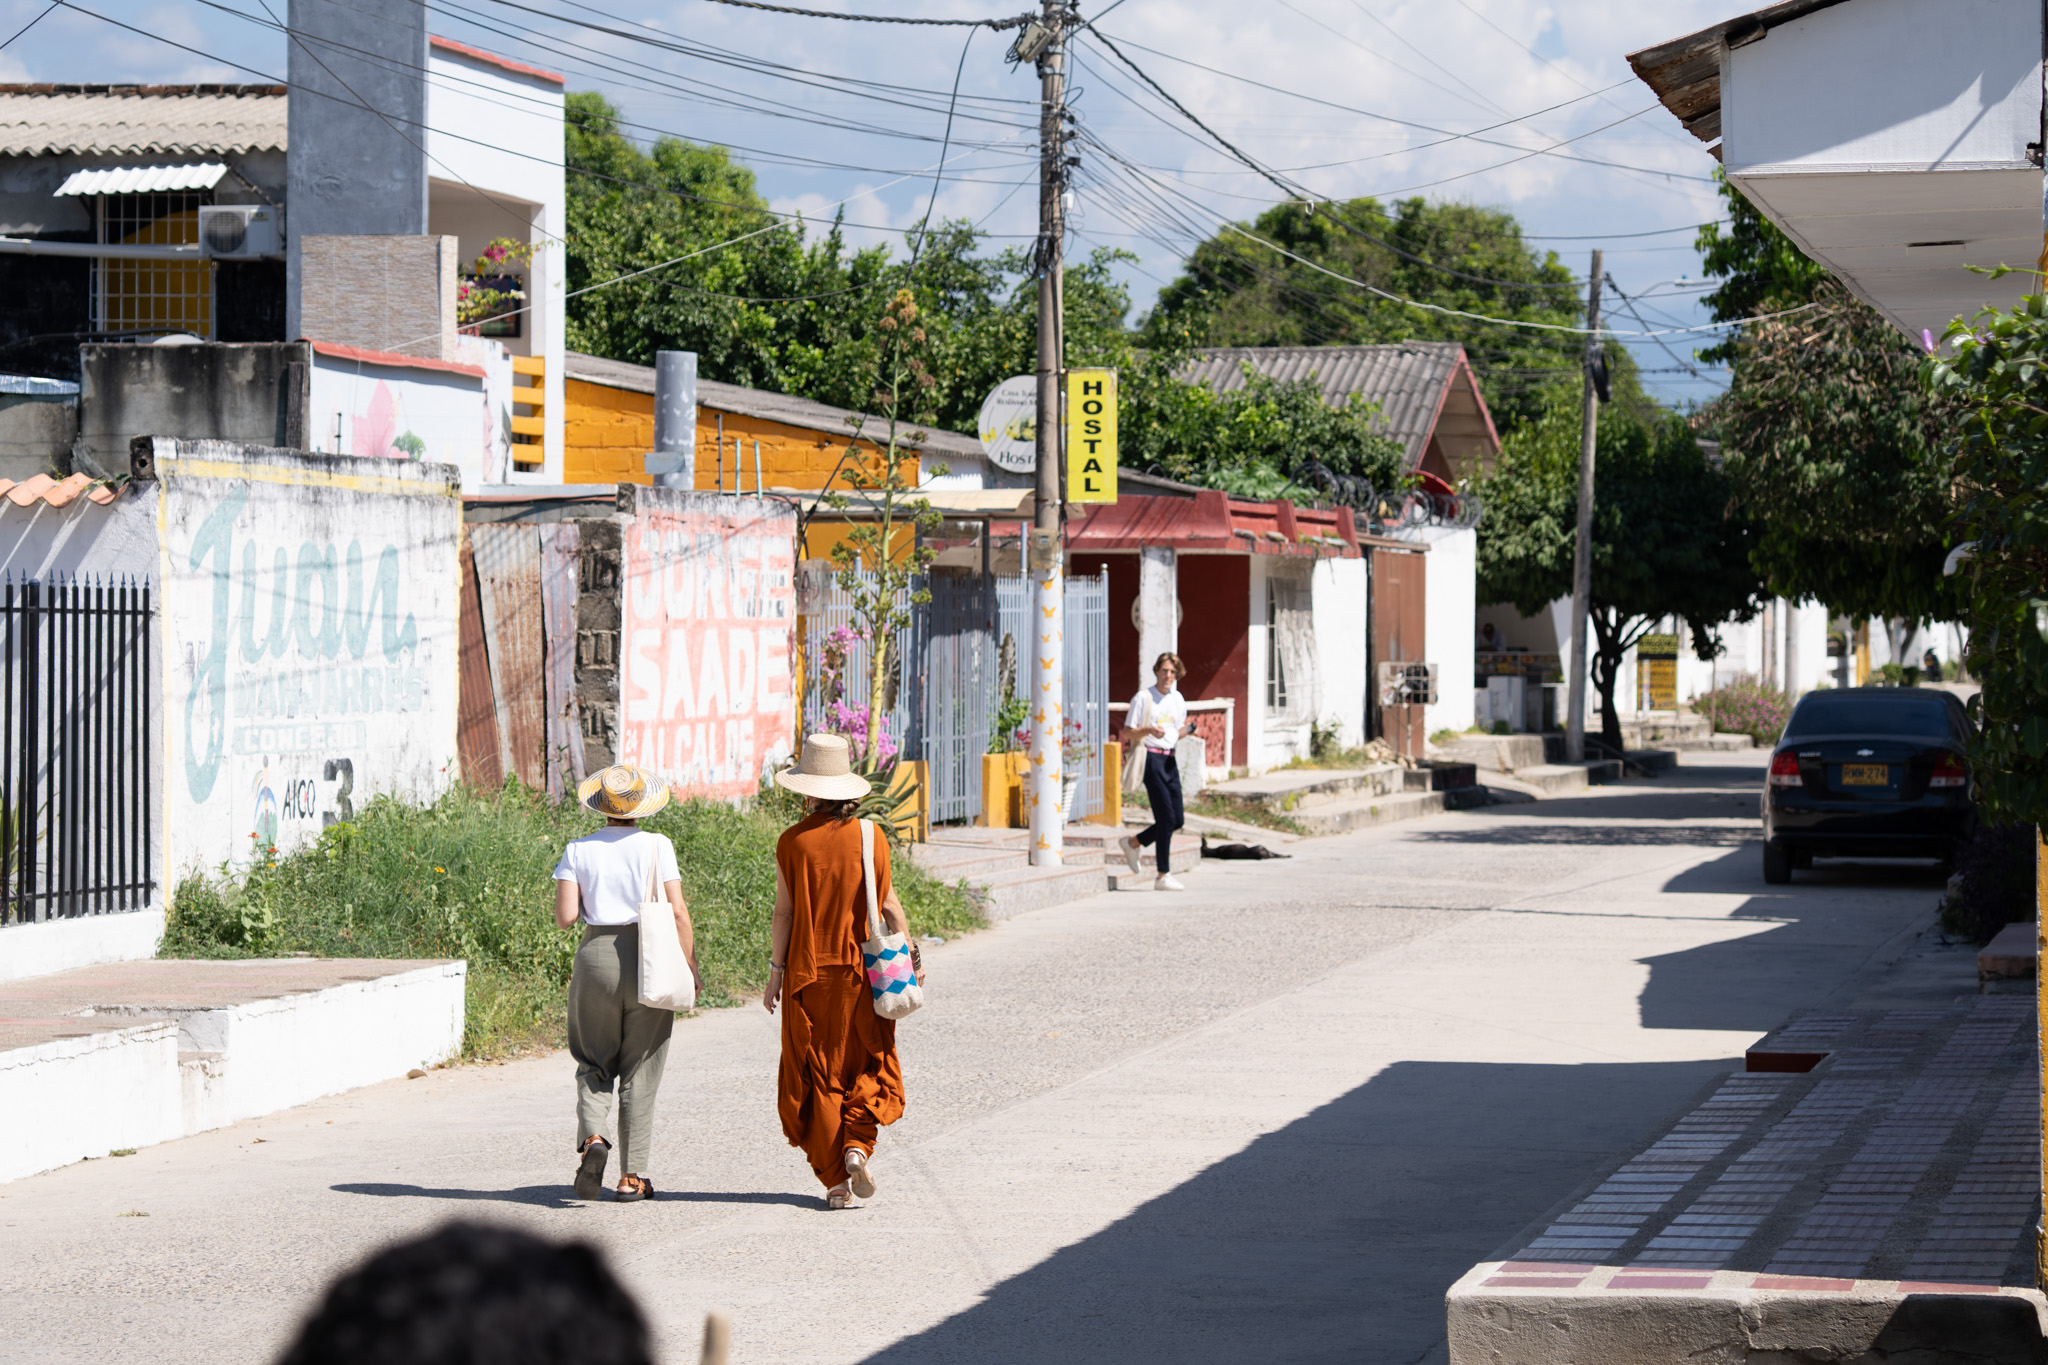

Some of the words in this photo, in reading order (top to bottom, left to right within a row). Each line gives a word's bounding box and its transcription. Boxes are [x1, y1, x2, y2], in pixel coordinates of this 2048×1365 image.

[999, 451, 1036, 465] HOST
[1082, 380, 1103, 492] HOSTAL
[630, 529, 792, 620] JORGE
[185, 484, 418, 805] Juan
[628, 627, 789, 722] SAADE
[282, 778, 316, 821] AICO
[322, 757, 354, 828] 3
[639, 718, 754, 787] ALCALDE
